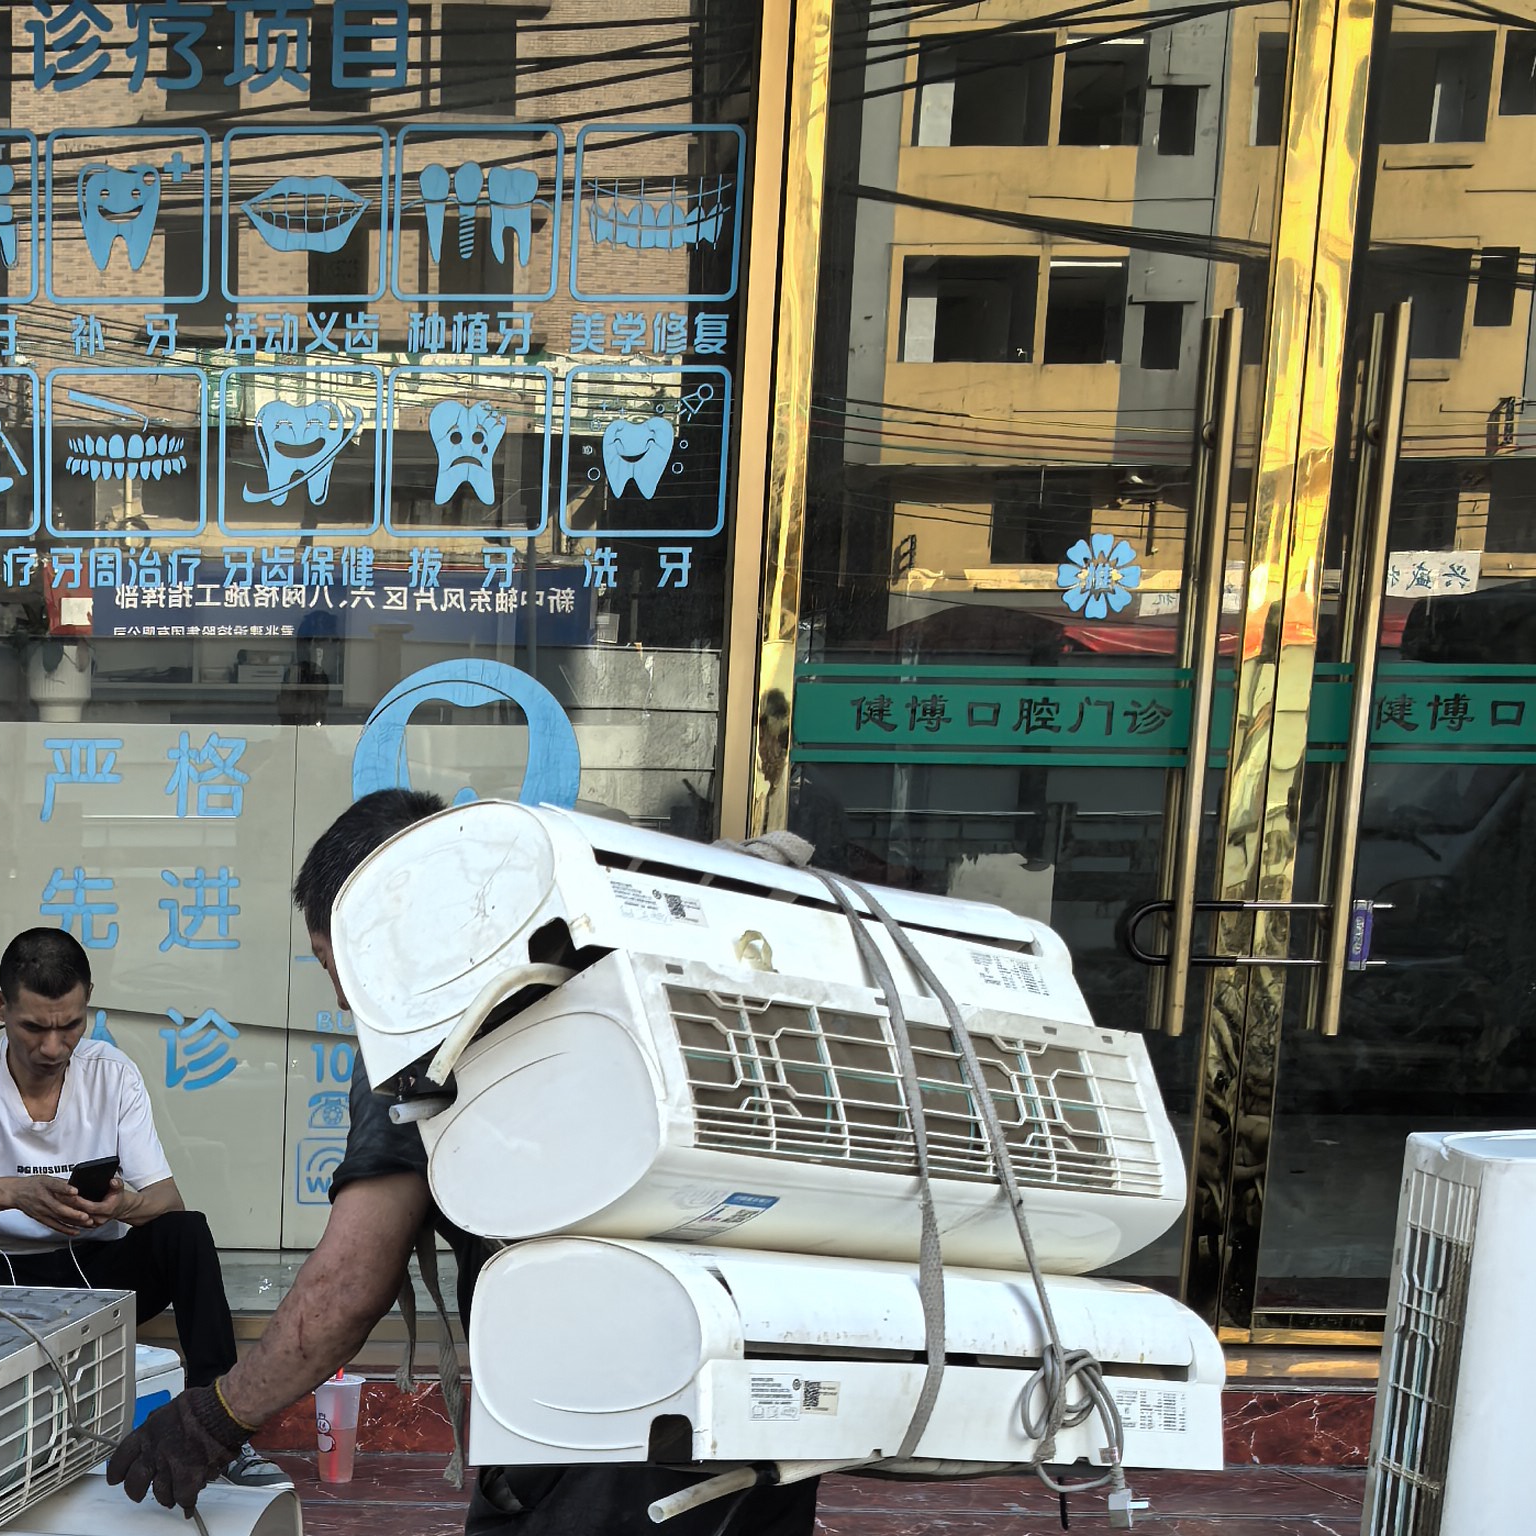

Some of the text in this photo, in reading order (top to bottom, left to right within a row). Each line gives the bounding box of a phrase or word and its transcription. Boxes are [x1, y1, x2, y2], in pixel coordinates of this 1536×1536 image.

[24, 0, 408, 92] 诊疗项目
[224, 312, 380, 355] 活动义齿
[407, 312, 533, 355] 种植牙
[571, 312, 729, 355] 美学修复
[50, 546, 201, 588] 牙周治疗
[222, 546, 375, 588] 牙齿保健
[851, 693, 1173, 736] 健博口腔门诊
[1376, 693, 1526, 731] 健博口
